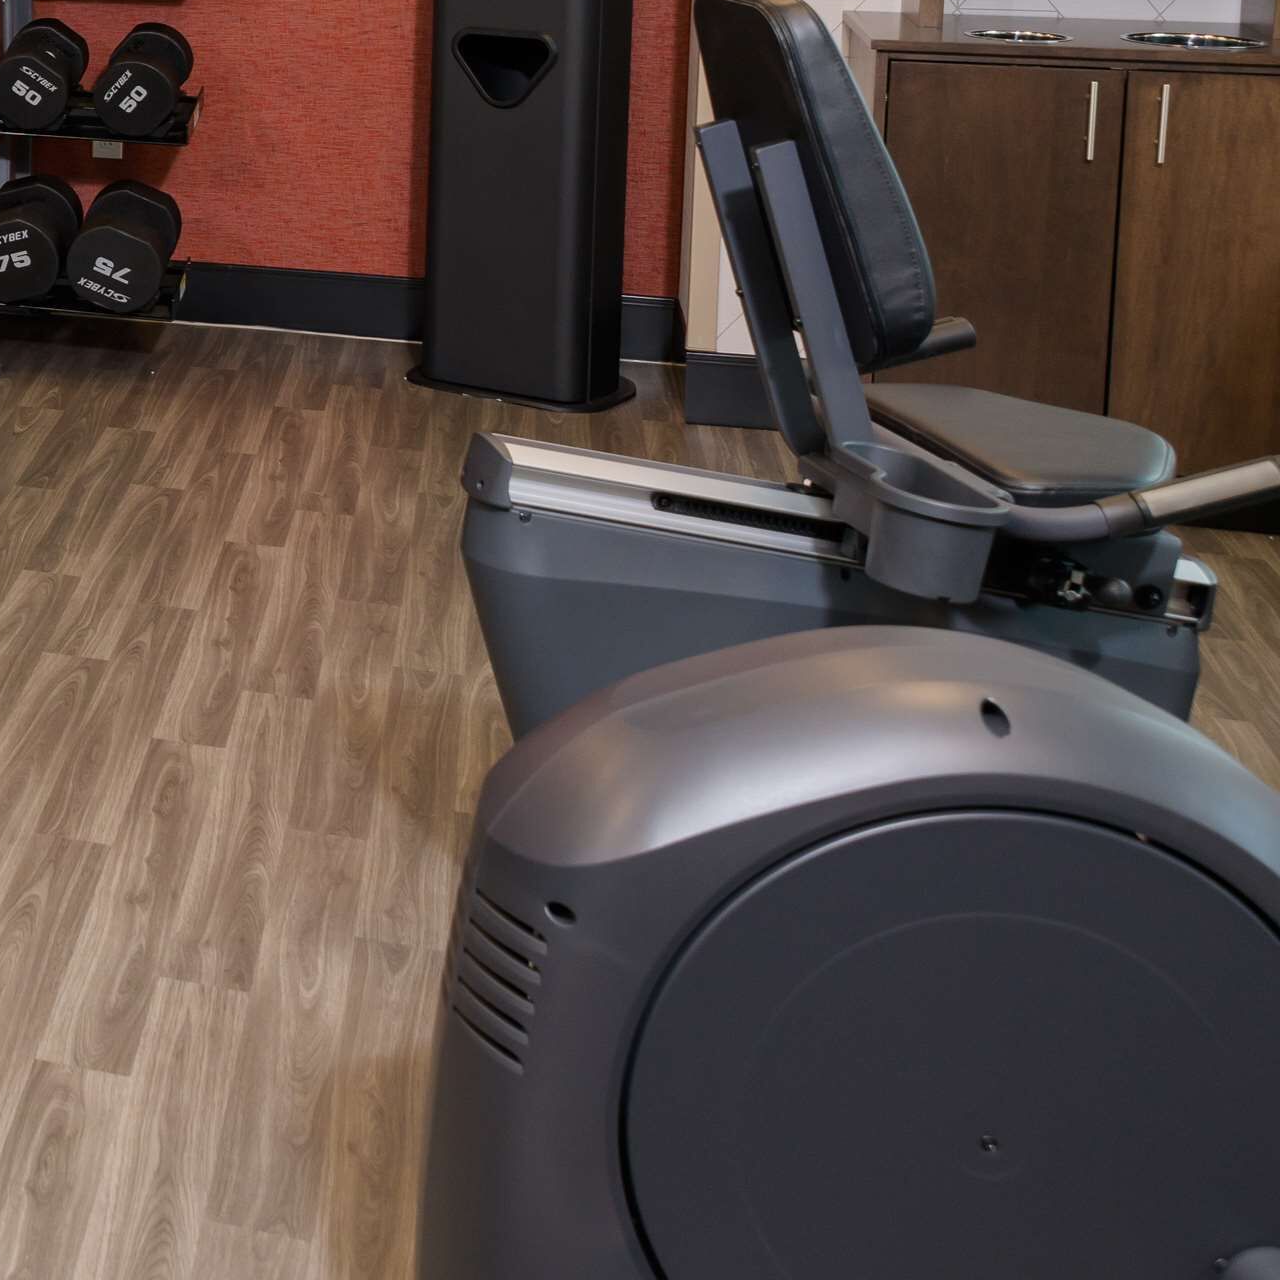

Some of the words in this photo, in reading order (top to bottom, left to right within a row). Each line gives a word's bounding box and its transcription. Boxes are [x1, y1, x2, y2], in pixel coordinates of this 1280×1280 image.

[11, 80, 42, 106] 50
[118, 85, 148, 113] 50
[93, 256, 132, 285] 75
[77, 276, 116, 299] CYBEX
